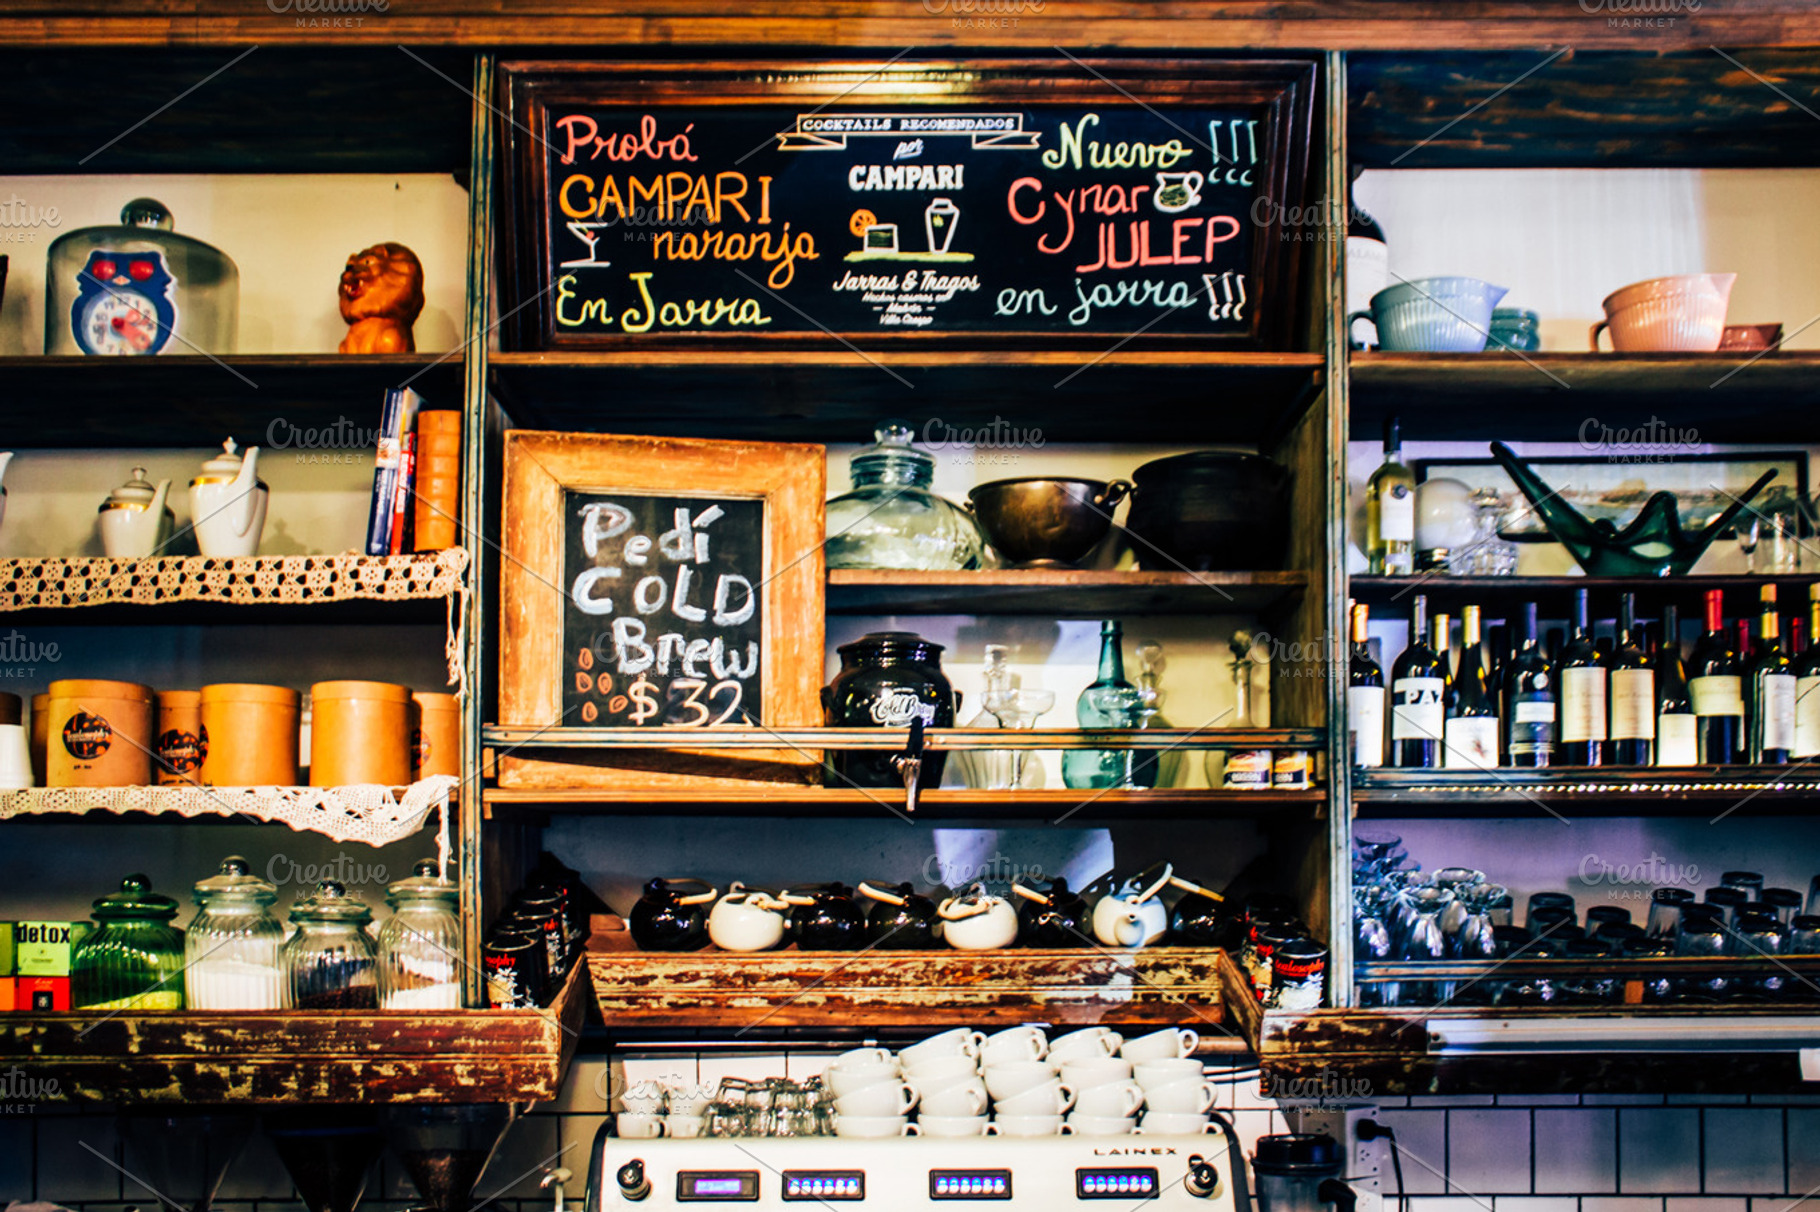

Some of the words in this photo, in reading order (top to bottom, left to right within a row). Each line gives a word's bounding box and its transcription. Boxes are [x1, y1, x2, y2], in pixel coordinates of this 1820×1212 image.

[556, 114, 699, 165] Probá
[802, 118, 892, 131] COCKTAILS
[900, 117, 1015, 131] RECOMENDADOS
[893, 138, 924, 161] por
[1042, 113, 1194, 170] Nuevo
[559, 171, 774, 225] CAMPARI
[848, 164, 965, 191] CAMPARI
[1007, 176, 1150, 254] Cynar
[653, 221, 820, 290] naranja
[1075, 215, 1241, 273] JULEP
[556, 275, 613, 326] En
[621, 272, 772, 332] Jarra
[832, 270, 900, 291] Jarras
[901, 269, 918, 291] &
[920, 270, 981, 301] Tragos
[994, 287, 1058, 316] en
[1068, 277, 1198, 326] jarra
[577, 502, 725, 565] Pedí
[571, 564, 756, 627] COLD
[611, 616, 759, 680] Brew
[17, 923, 70, 943] detox
[1093, 1147, 1178, 1156] LAINEX
